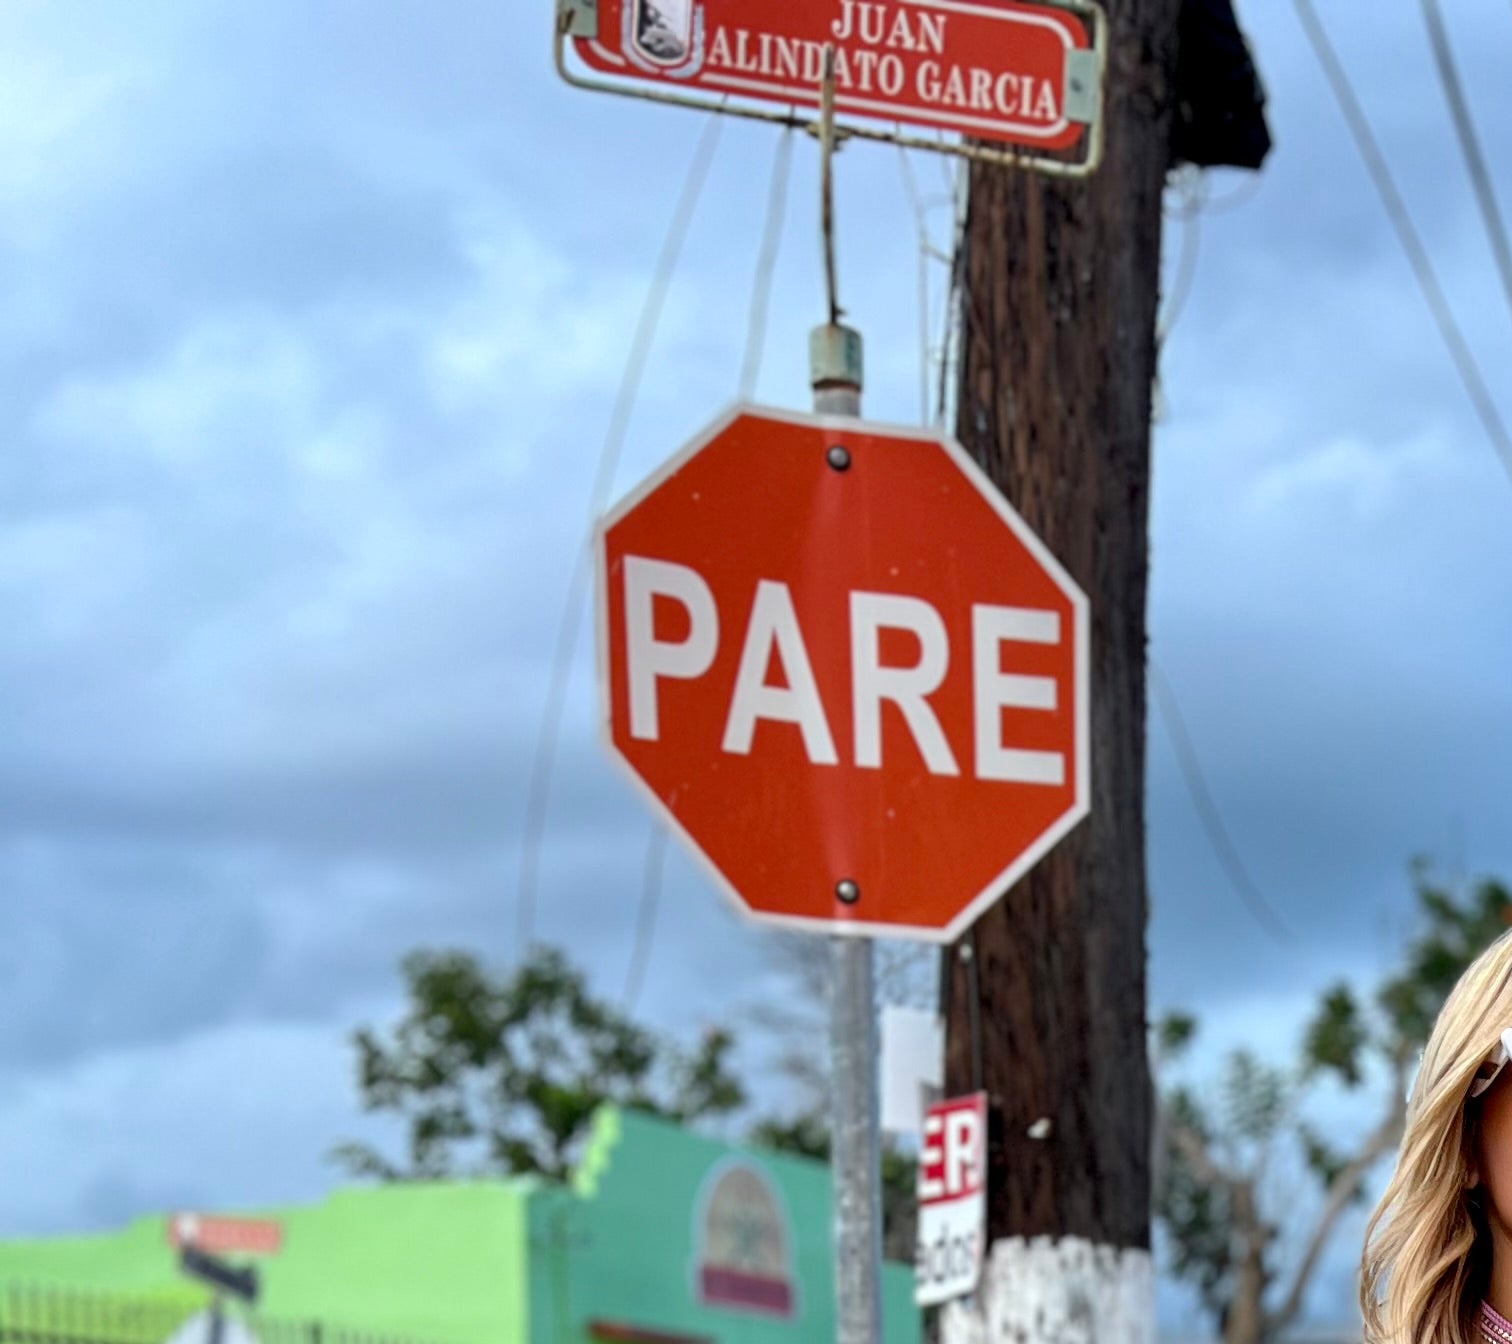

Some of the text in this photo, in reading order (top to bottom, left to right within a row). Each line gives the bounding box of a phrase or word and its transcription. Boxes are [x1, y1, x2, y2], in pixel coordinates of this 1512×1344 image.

[831, 0, 944, 54] JUAN
[916, 60, 1057, 120] GARCIA
[623, 554, 1065, 786] PARE
